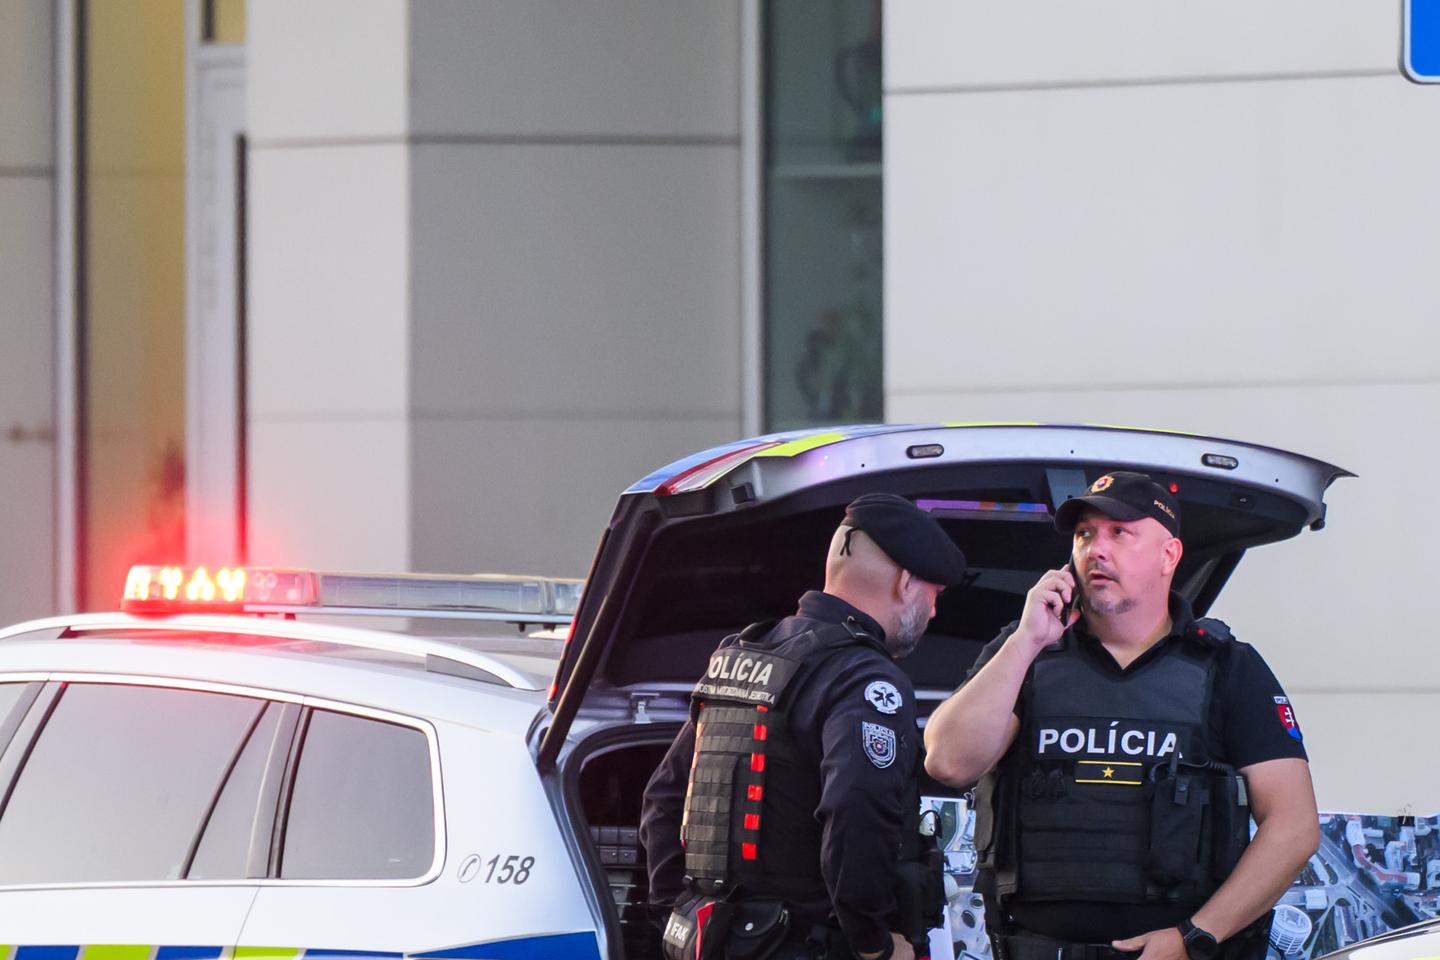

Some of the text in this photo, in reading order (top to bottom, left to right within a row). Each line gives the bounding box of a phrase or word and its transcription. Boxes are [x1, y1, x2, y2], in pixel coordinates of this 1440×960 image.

[708, 652, 773, 686] OLÍCIA
[1038, 720, 1184, 759] POLÍCIA
[485, 854, 535, 885] 158
